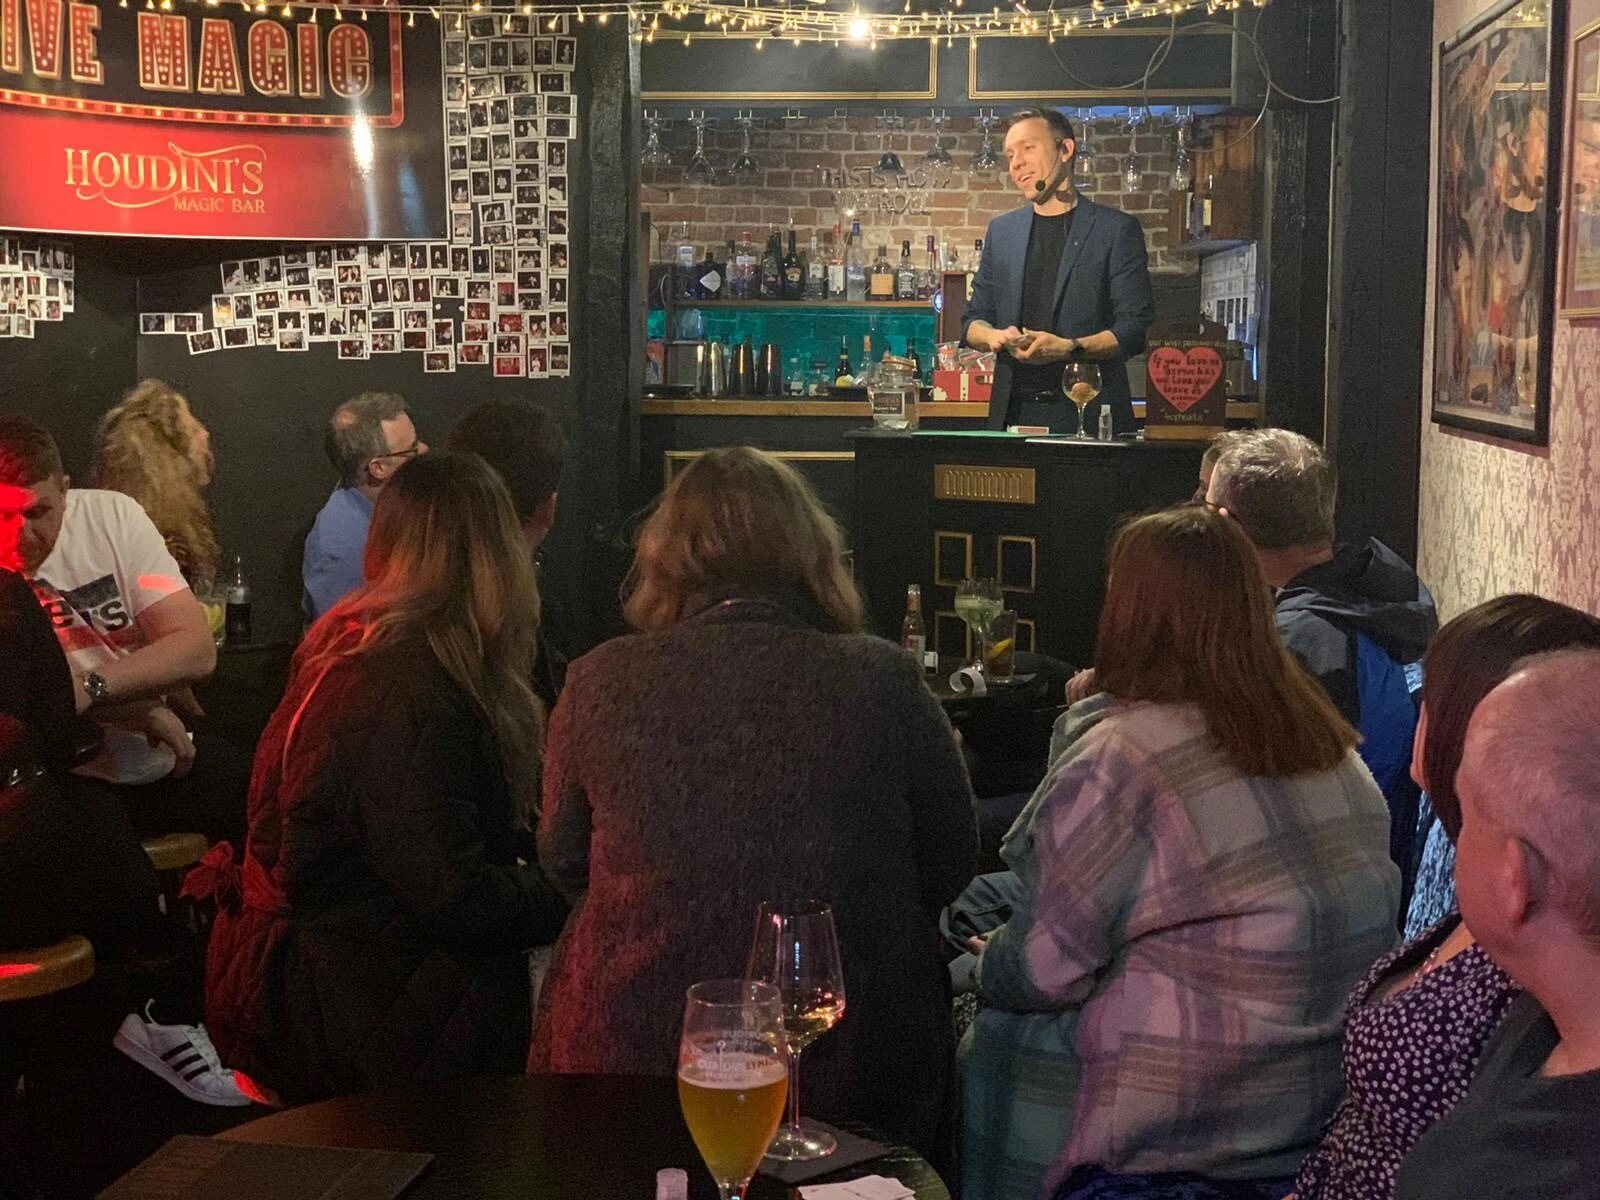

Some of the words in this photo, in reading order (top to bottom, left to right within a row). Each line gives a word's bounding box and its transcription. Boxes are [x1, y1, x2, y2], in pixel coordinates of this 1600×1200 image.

[137, 12, 373, 98] MAGIC
[65, 145, 265, 204] HOUDINI'S
[173, 197, 225, 212] MAGIC
[232, 199, 266, 214] BAR
